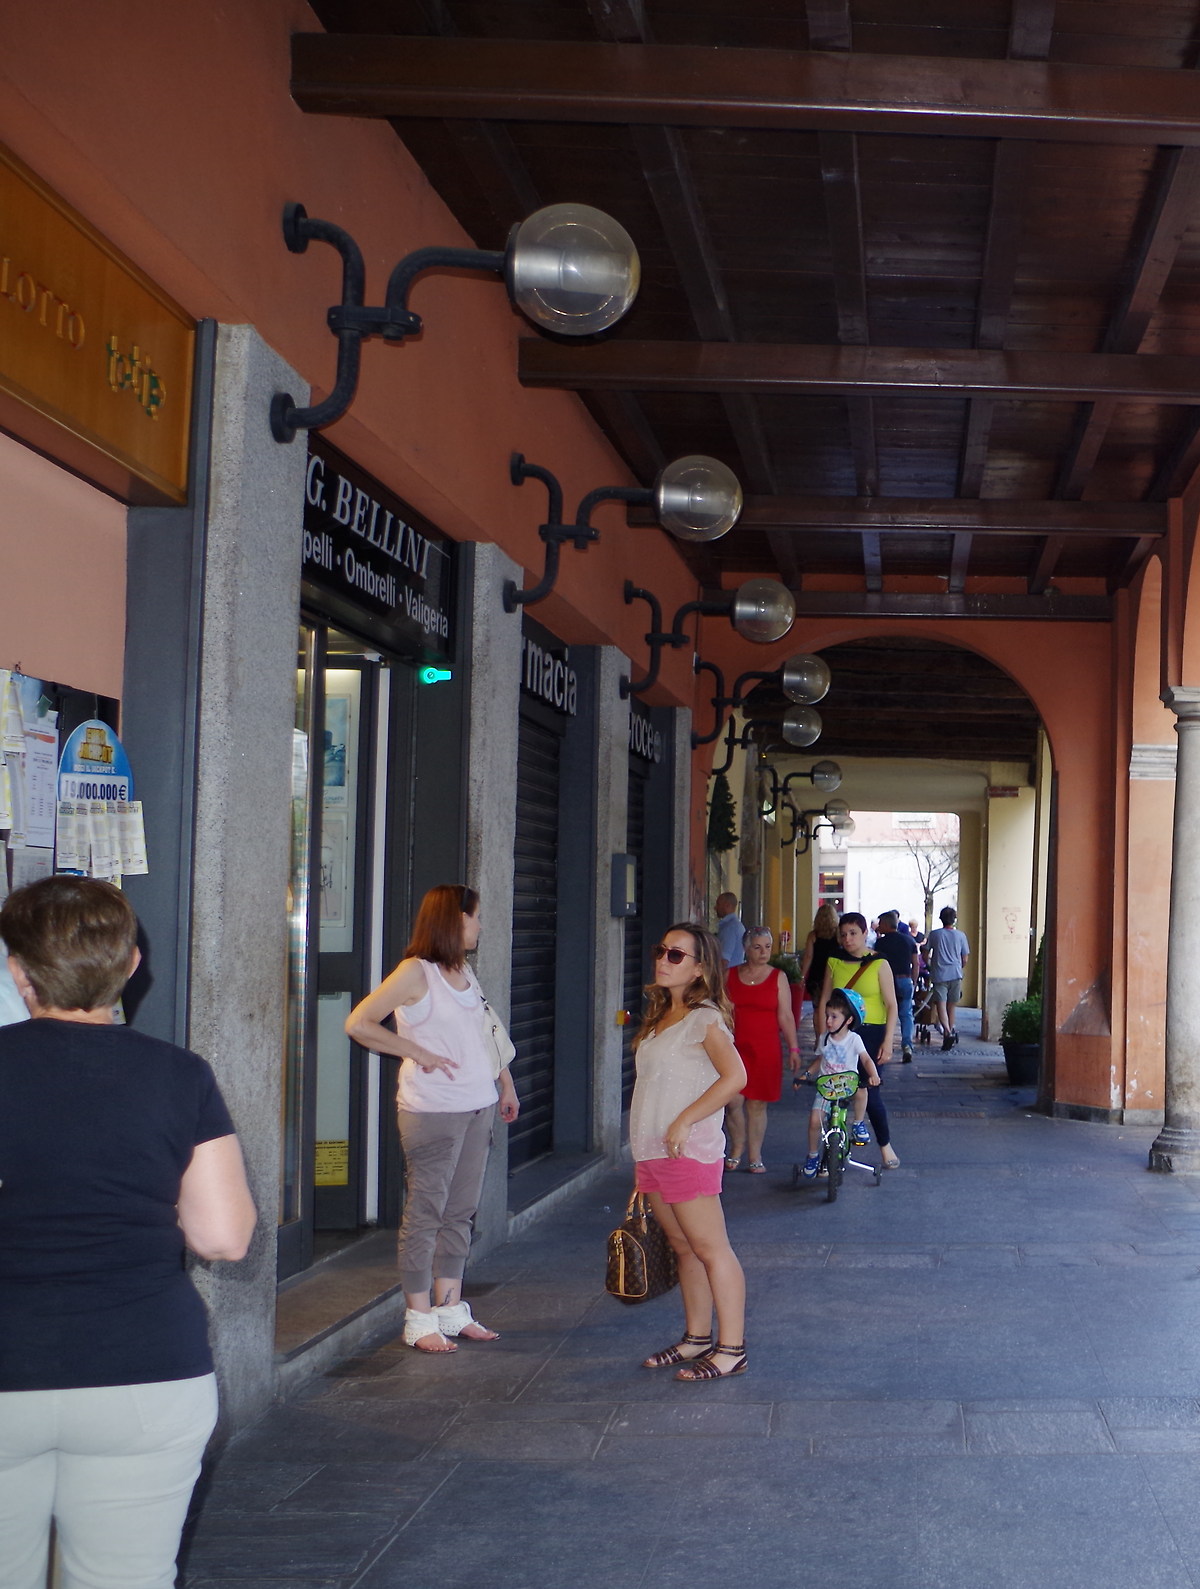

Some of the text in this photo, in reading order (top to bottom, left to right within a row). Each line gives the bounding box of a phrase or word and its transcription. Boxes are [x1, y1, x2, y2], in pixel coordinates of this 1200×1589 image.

[0, 258, 86, 350] LOTTO
[306, 455, 433, 580] G. BELLINI
[345, 547, 396, 608] Ombrelli
[405, 585, 449, 639] Valigeria
[629, 712, 654, 761] roce
